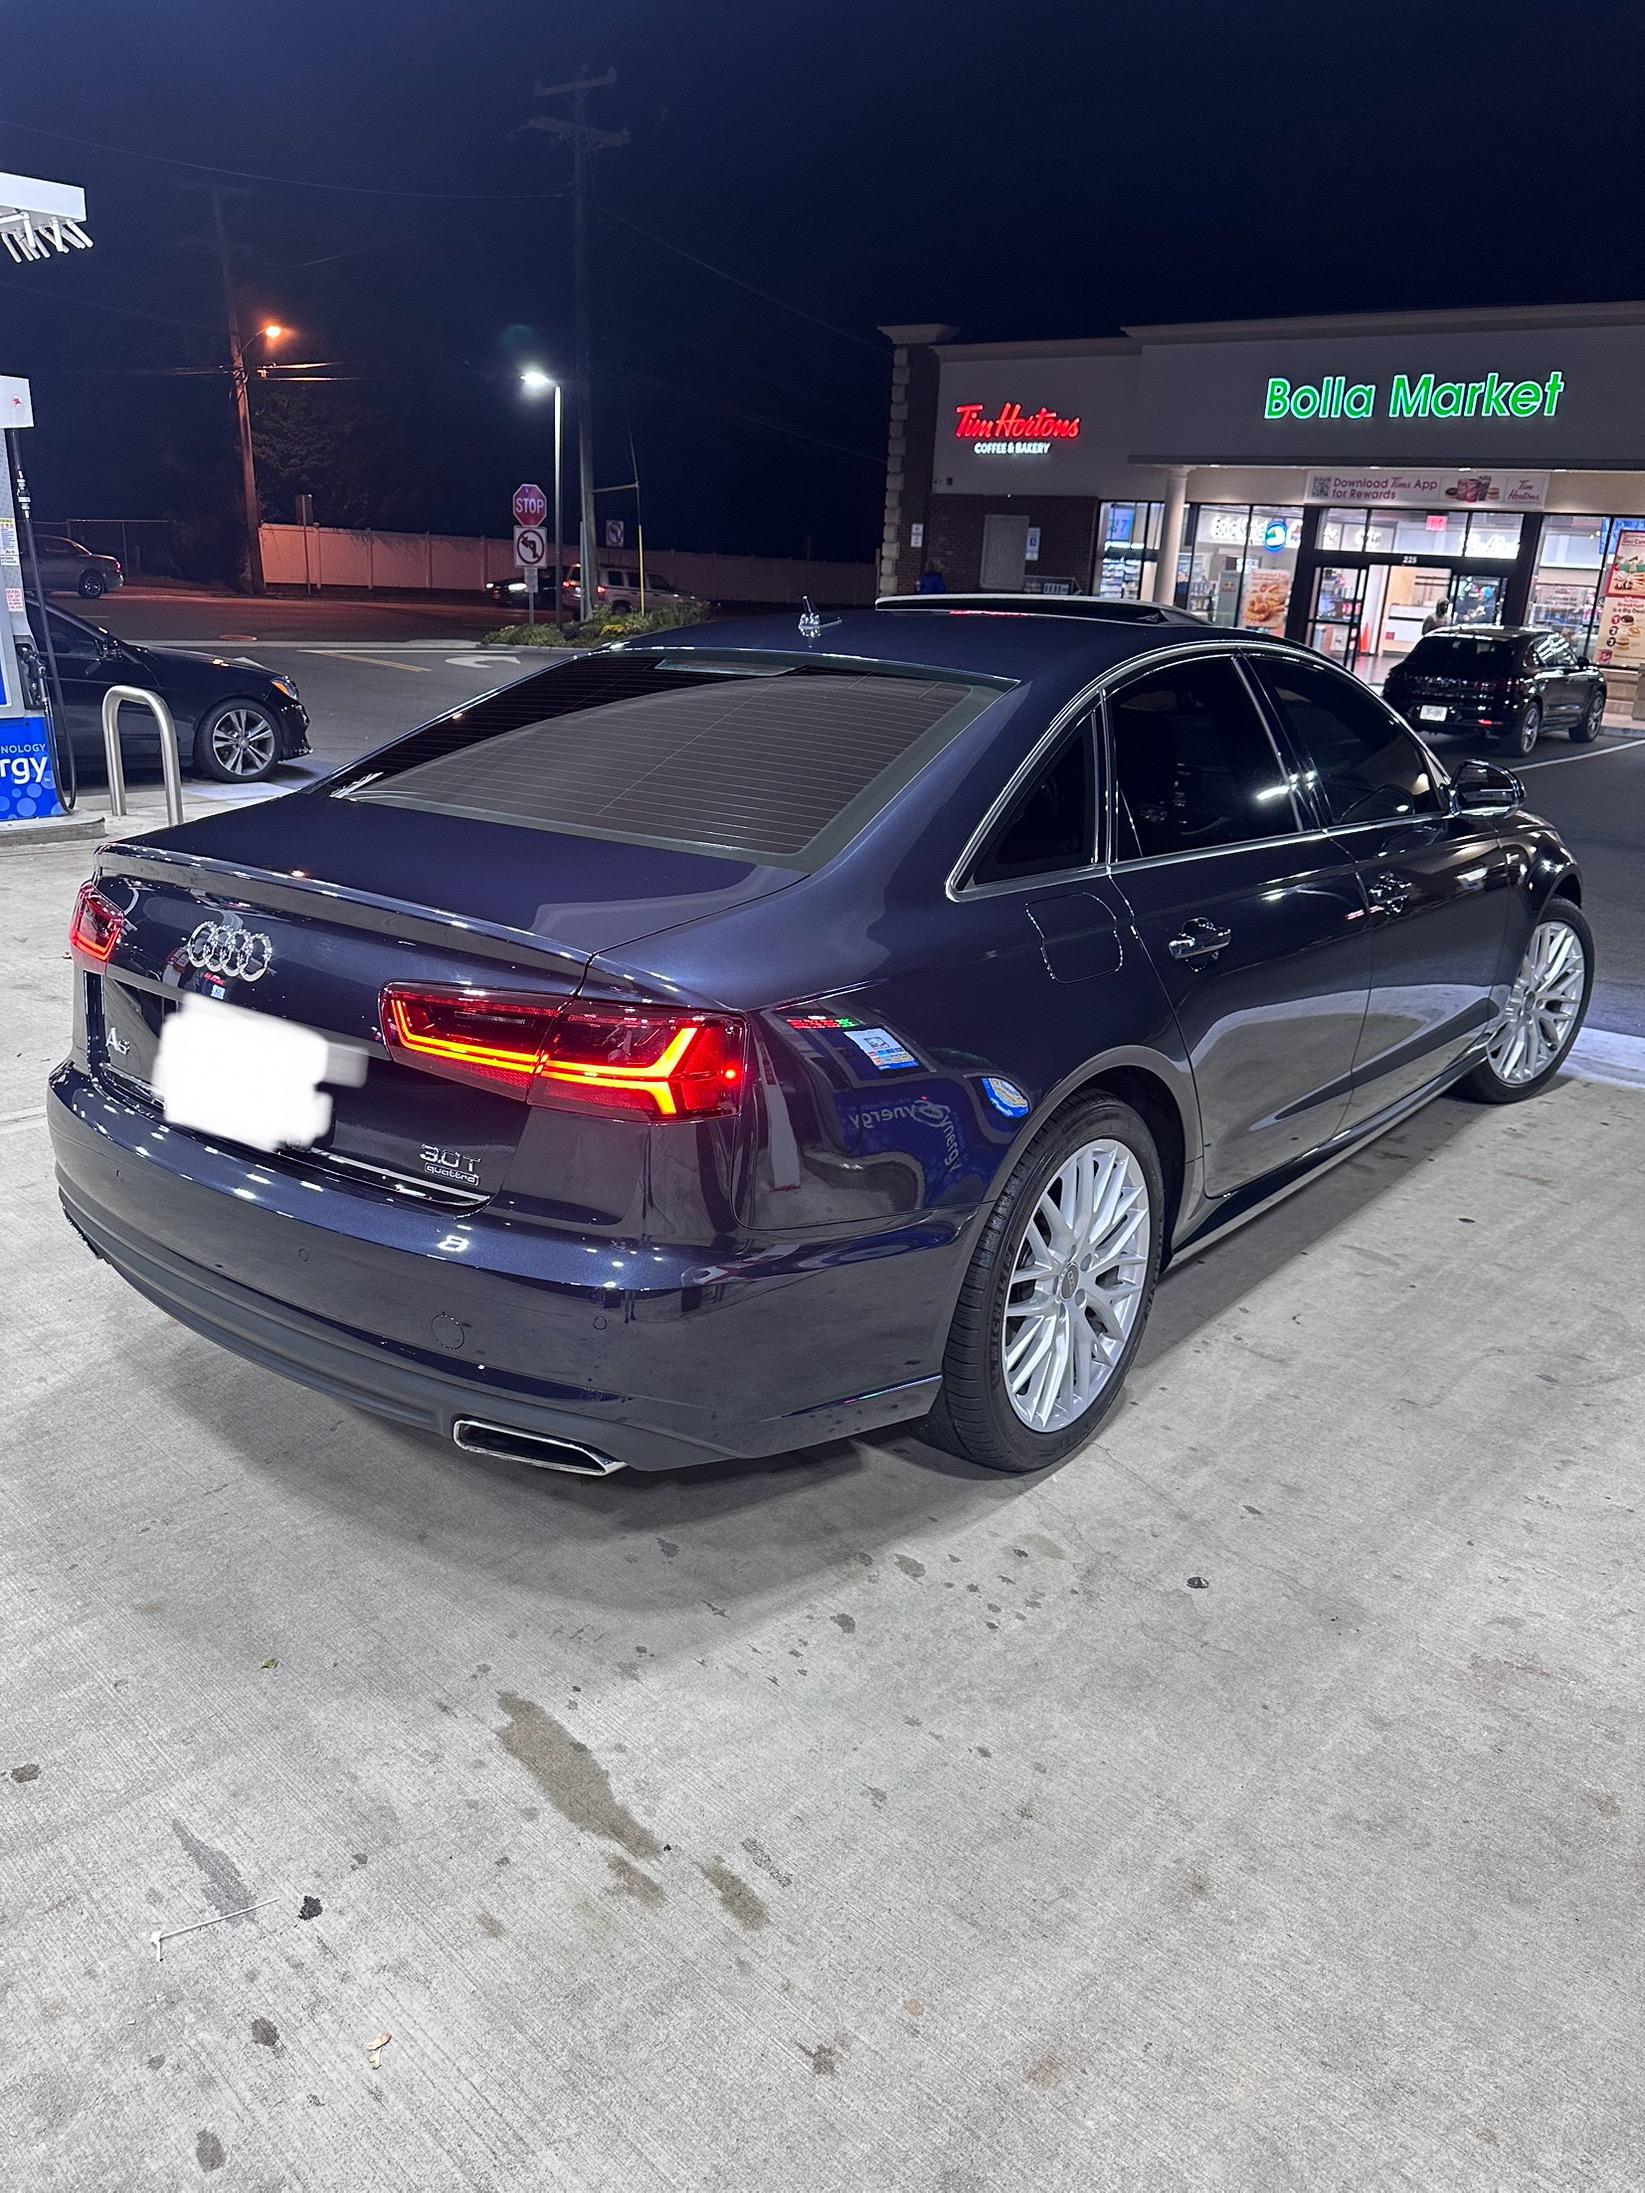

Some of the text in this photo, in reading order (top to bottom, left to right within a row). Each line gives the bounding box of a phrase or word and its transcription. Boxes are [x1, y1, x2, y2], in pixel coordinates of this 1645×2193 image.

[1264, 371, 1565, 420] Bolla Market
[956, 402, 1080, 438] Tim Hortons
[974, 441, 1051, 454] COFFEE & BAKERY
[1333, 478, 1389, 489] Download
[1413, 479, 1438, 491] App
[1332, 488, 1396, 499] for Rewards
[516, 498, 545, 514] STOP
[0, 743, 46, 754] NOLOGY
[0, 756, 48, 784] rgy
[426, 1165, 476, 1183] quattro
